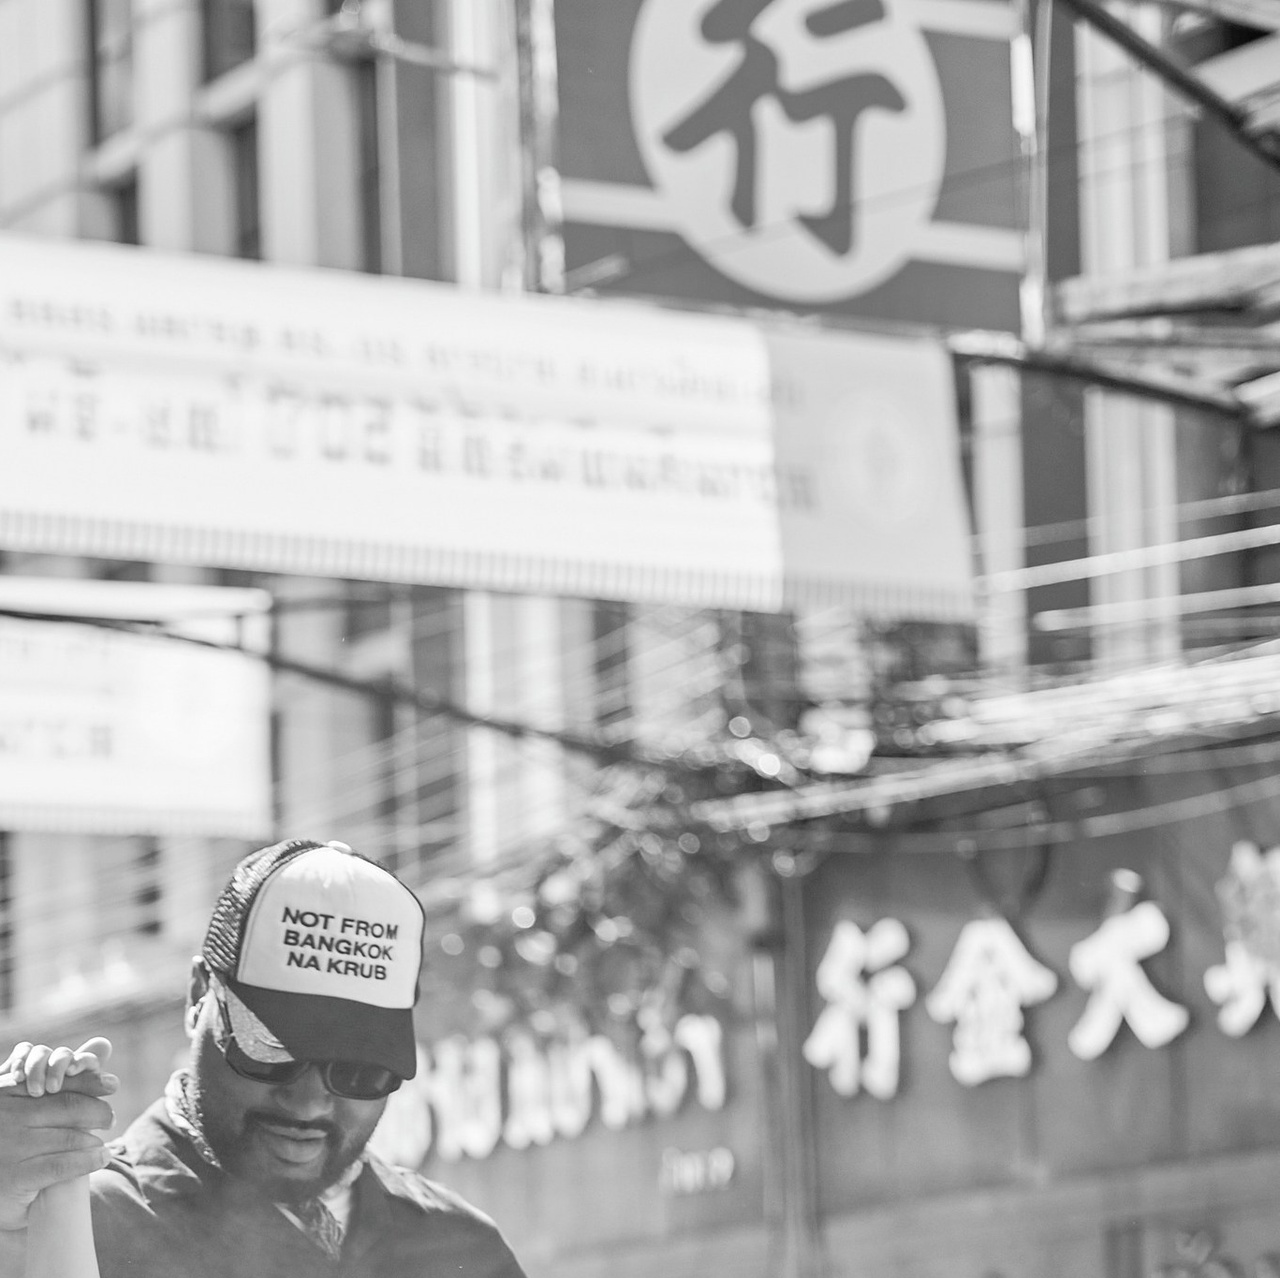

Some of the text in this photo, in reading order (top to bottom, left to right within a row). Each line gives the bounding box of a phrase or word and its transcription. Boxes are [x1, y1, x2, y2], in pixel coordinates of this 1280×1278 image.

[663, 0, 907, 257] 行
[281, 906, 399, 940] NOT FROM
[283, 928, 394, 961] BANGKOK
[287, 951, 387, 980] NA KRUB
